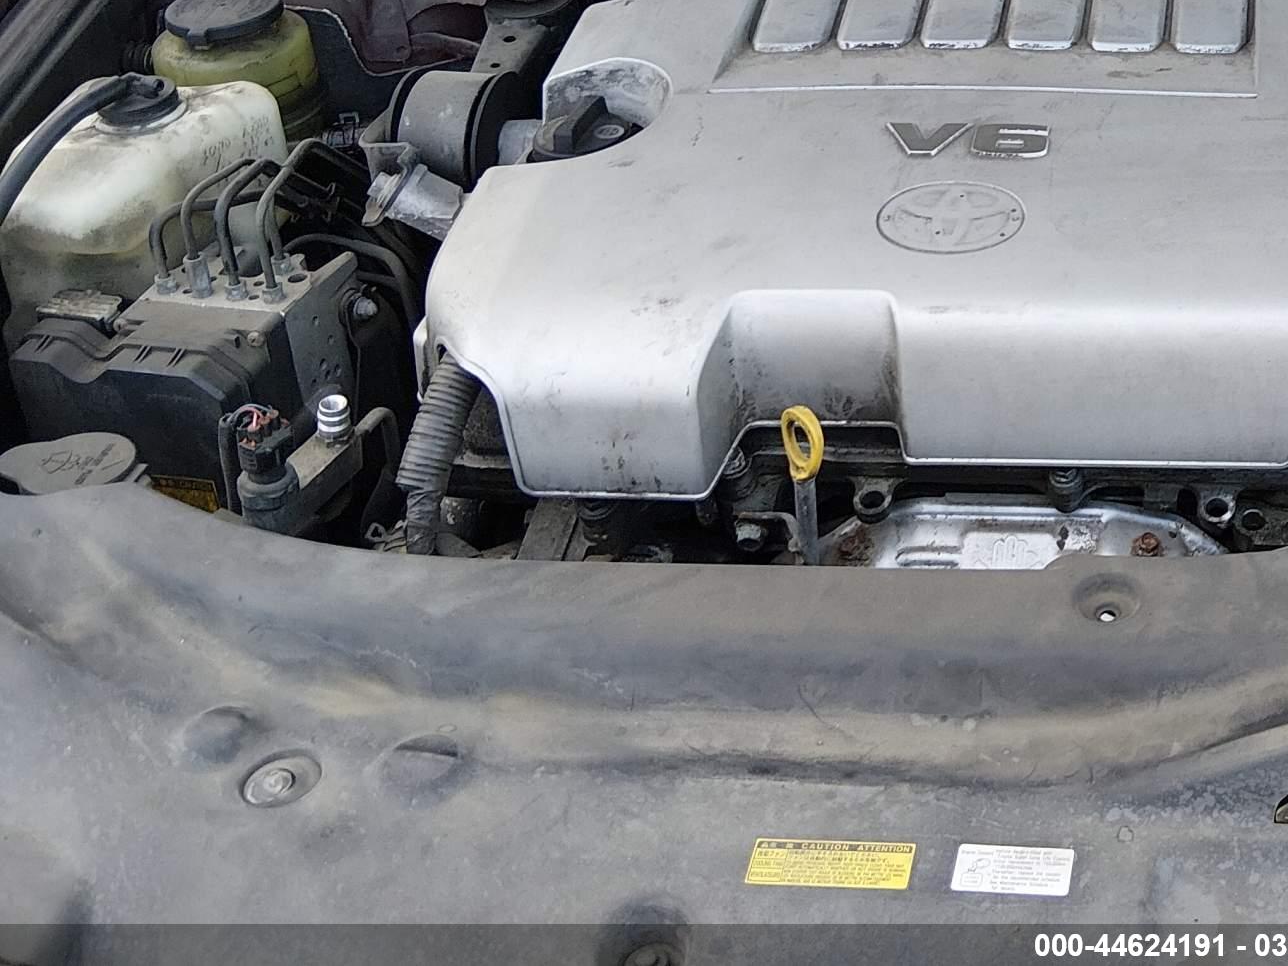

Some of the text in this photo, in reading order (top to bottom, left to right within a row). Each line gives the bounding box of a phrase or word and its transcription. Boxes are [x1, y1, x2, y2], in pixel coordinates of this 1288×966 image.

[885, 122, 1052, 159] V6
[801, 842, 849, 851] CAUTION
[857, 844, 911, 853] ATTENTION
